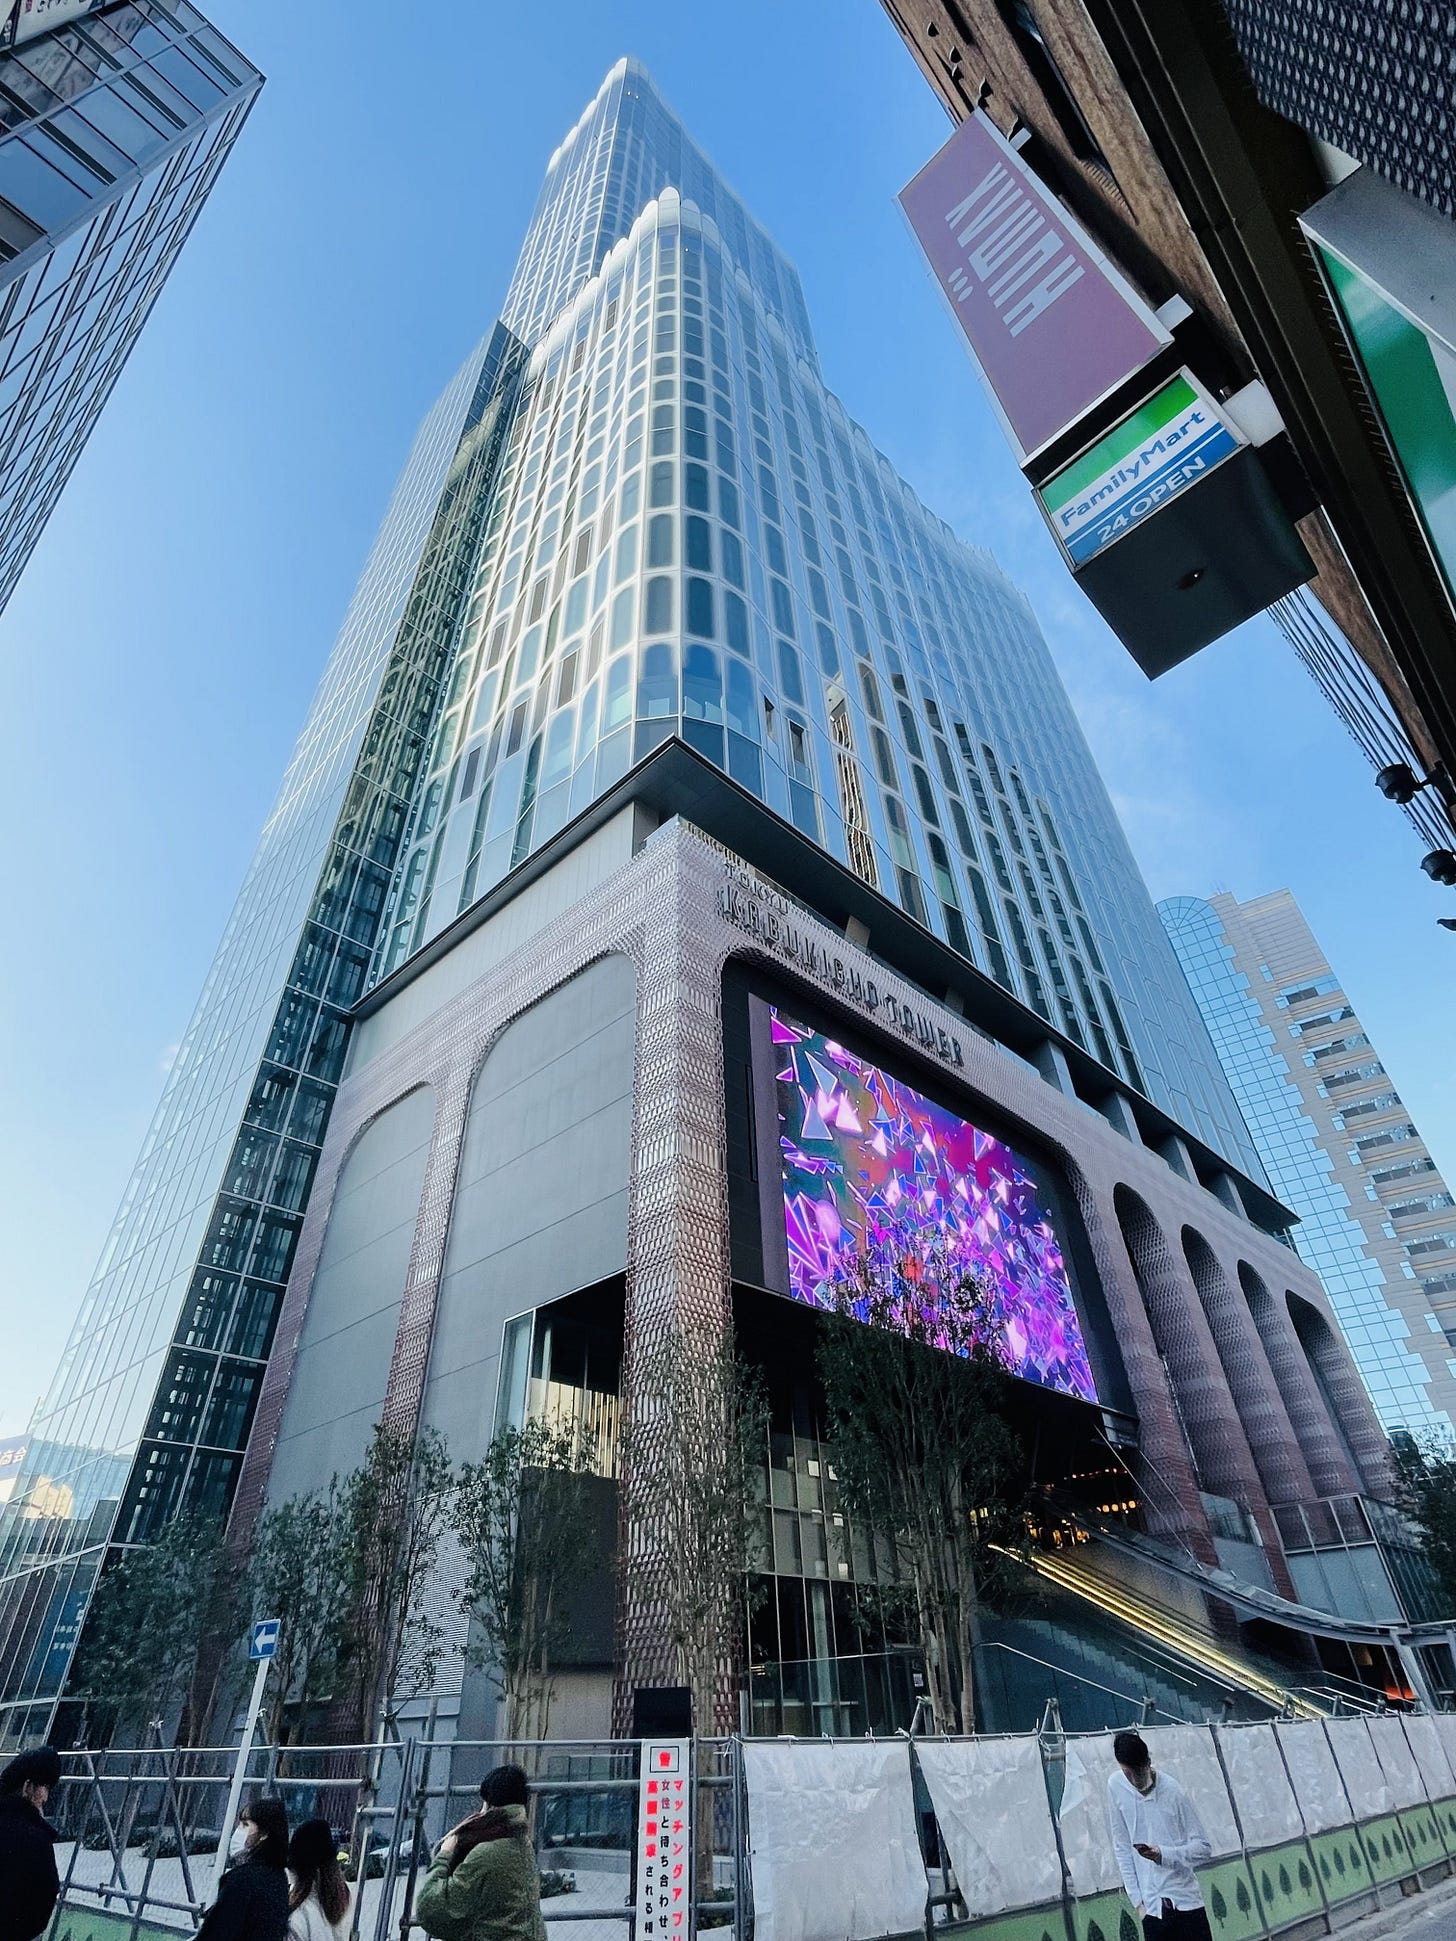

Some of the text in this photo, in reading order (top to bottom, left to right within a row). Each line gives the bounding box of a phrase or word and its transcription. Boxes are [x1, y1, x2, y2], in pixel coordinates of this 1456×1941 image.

[945, 161, 1086, 338] HUMAX
[1060, 411, 1205, 527] FamilyMart
[724, 862, 789, 916] TOKYU
[721, 884, 964, 1067] KABUKICHO TOWER
